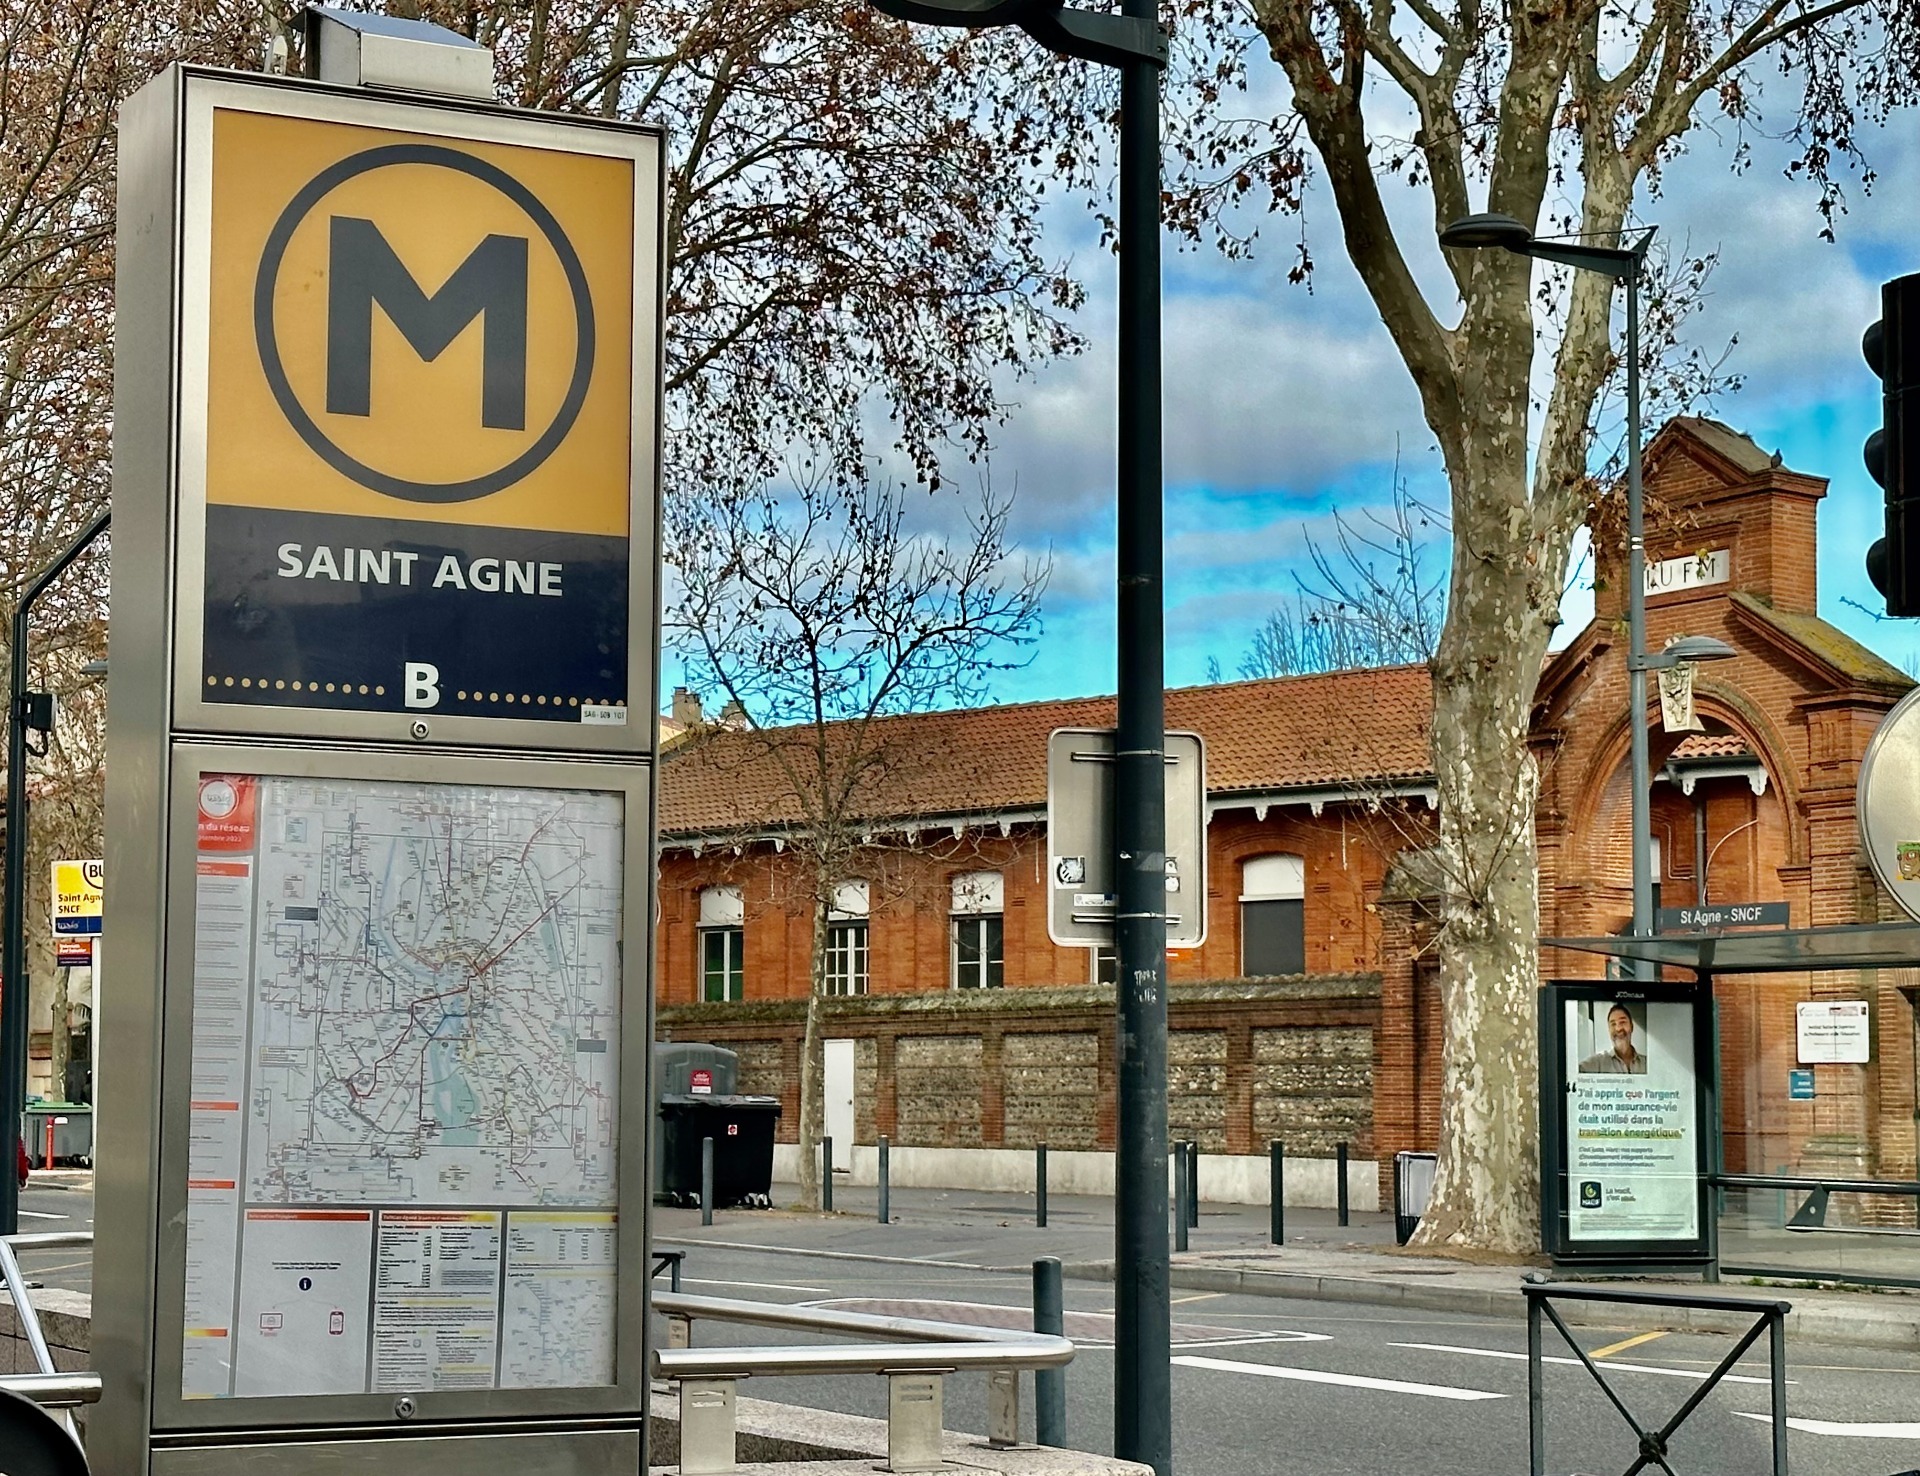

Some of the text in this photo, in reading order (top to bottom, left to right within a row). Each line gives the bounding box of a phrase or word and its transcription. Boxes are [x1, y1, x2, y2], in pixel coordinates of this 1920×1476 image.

[326, 214, 529, 431] M
[277, 542, 563, 597] SAINT AGNE
[404, 661, 440, 709] B
[58, 893, 104, 904] Saint Agn
[58, 905, 81, 914] SNCF
[1680, 910, 1692, 924] St
[1694, 910, 1721, 926] Agne
[1730, 906, 1762, 921] SNCF
[1595, 1088, 1623, 1100] appris
[1625, 1090, 1643, 1100] que
[1578, 1101, 1590, 1111] de
[1592, 1103, 1613, 1111] mon
[1578, 1114, 1599, 1124] était
[1631, 1114, 1653, 1124] dans
[1655, 1114, 1664, 1124] la
[1579, 1127, 1622, 1137] transition
